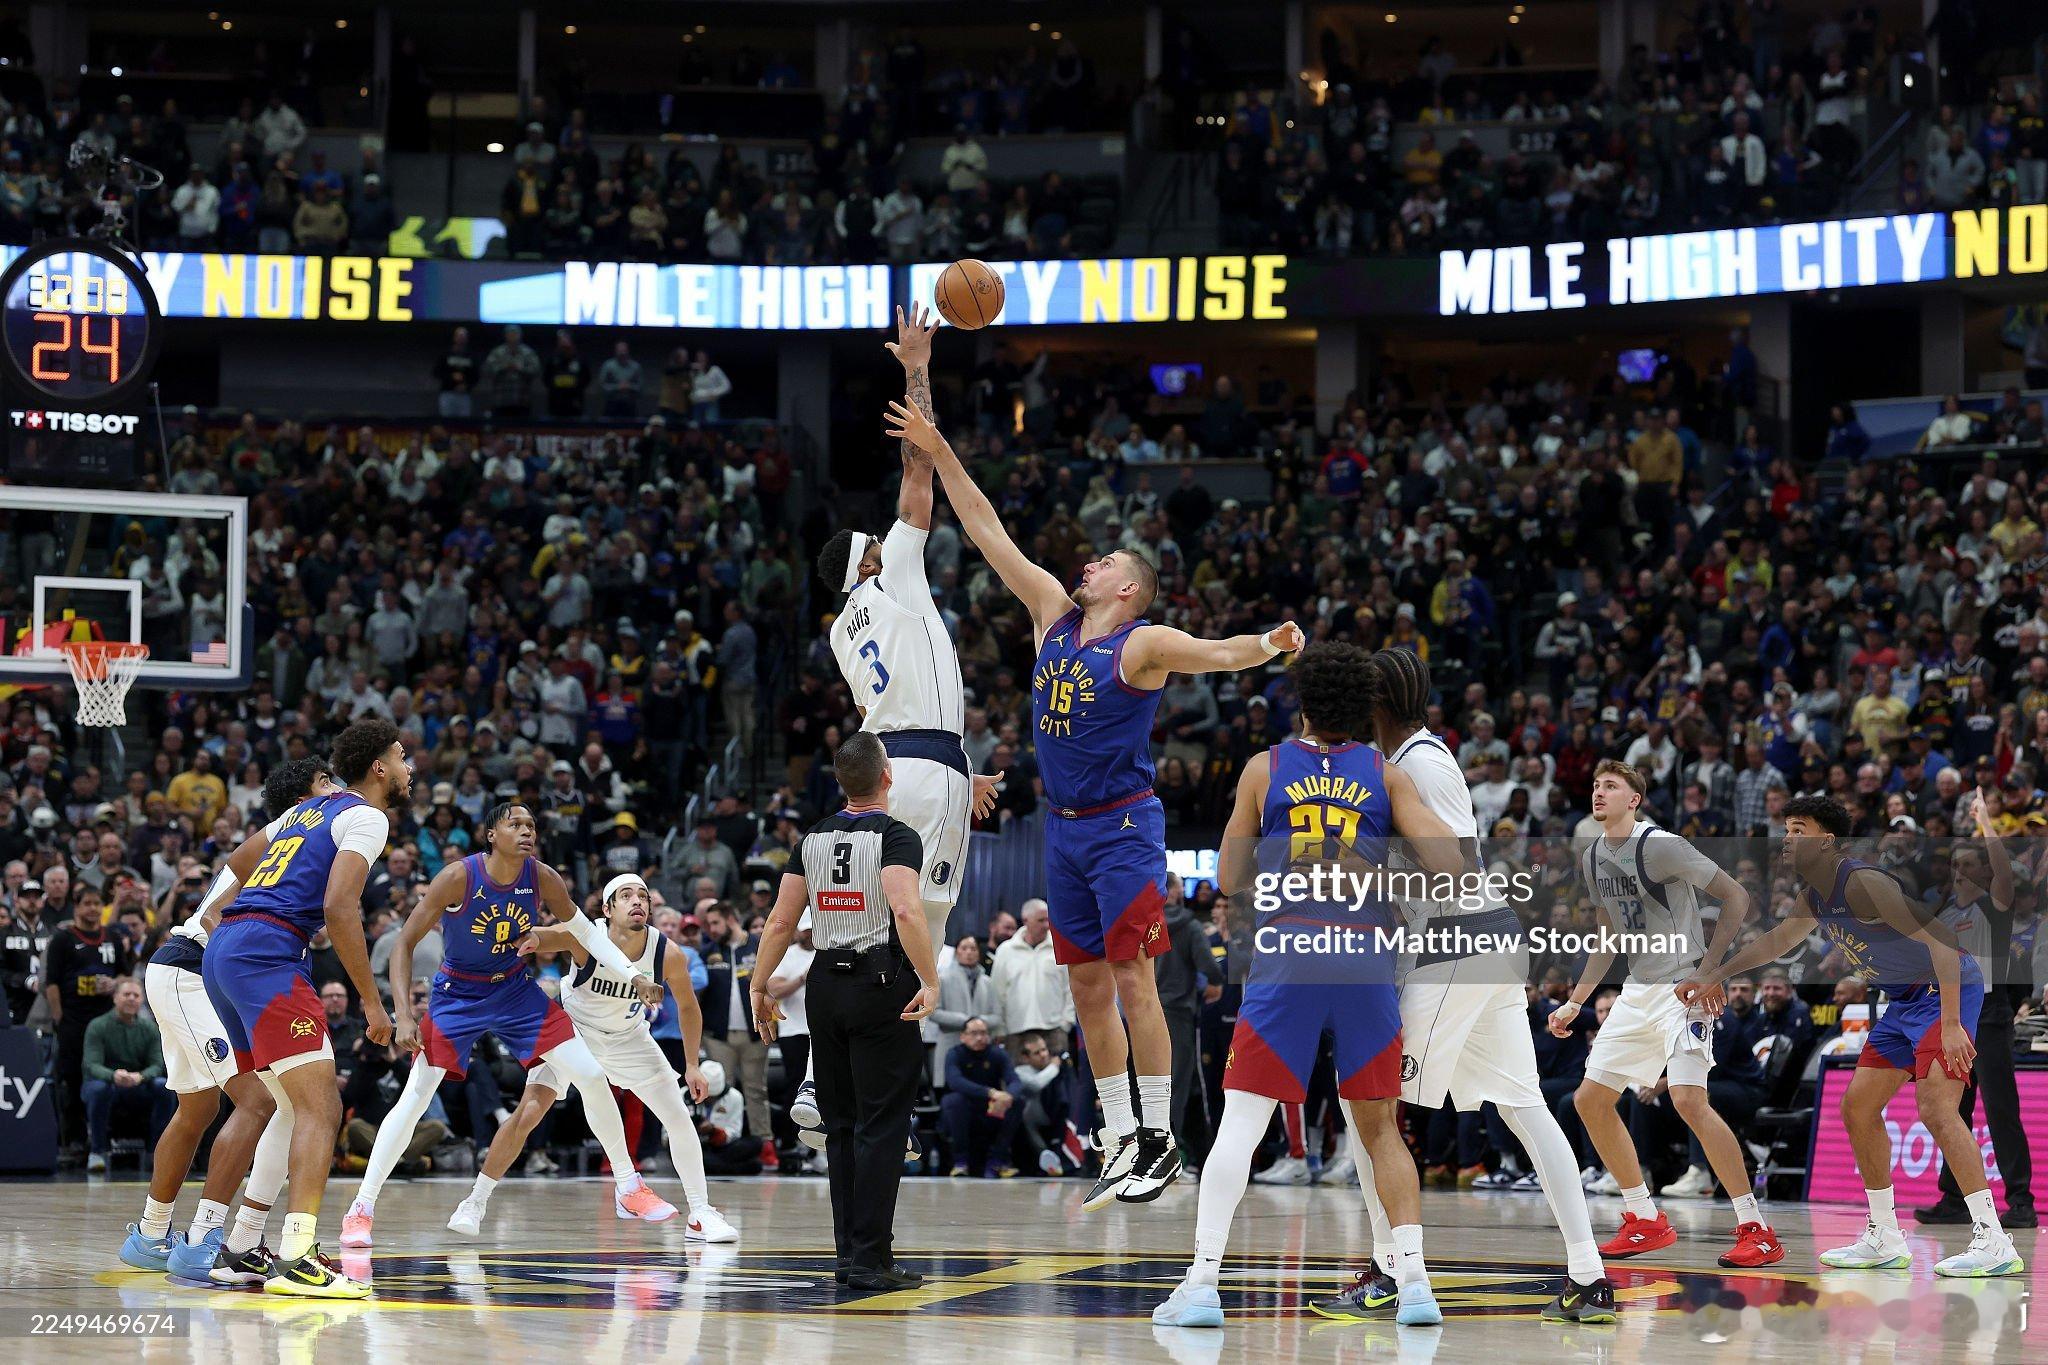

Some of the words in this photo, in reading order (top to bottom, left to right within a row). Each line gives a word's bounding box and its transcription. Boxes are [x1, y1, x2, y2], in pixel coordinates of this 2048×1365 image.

[1439, 240, 1587, 316] MILE
[1607, 226, 1759, 305] HIGH
[1781, 213, 1938, 292] CITY
[201, 254, 414, 321] NOISE
[564, 260, 681, 328] MILE
[738, 264, 891, 330] HIGH
[911, 260, 1062, 328] CY
[1078, 254, 1288, 321] NOISE
[32, 312, 120, 384] 24
[45, 411, 140, 435] TISSOT
[846, 606, 871, 641] DAVIS
[858, 639, 890, 695] 3
[1034, 658, 1068, 692] MILE
[1069, 660, 1095, 702] HIGH
[1049, 679, 1075, 714] 15
[1039, 714, 1072, 738] CITY
[1284, 774, 1373, 807] MURRAY
[1288, 803, 1362, 862] 27
[243, 836, 306, 889] 23
[831, 842, 853, 885] 3
[515, 887, 534, 895] ibotta
[822, 896, 861, 907] Emirates
[1598, 875, 1638, 898] DALLAS
[470, 903, 501, 935] MILE
[506, 901, 532, 934] HIGH
[1618, 899, 1646, 930] 32
[495, 921, 511, 943] 8
[590, 976, 640, 1000] DALLA
[625, 1001, 643, 1020] 9
